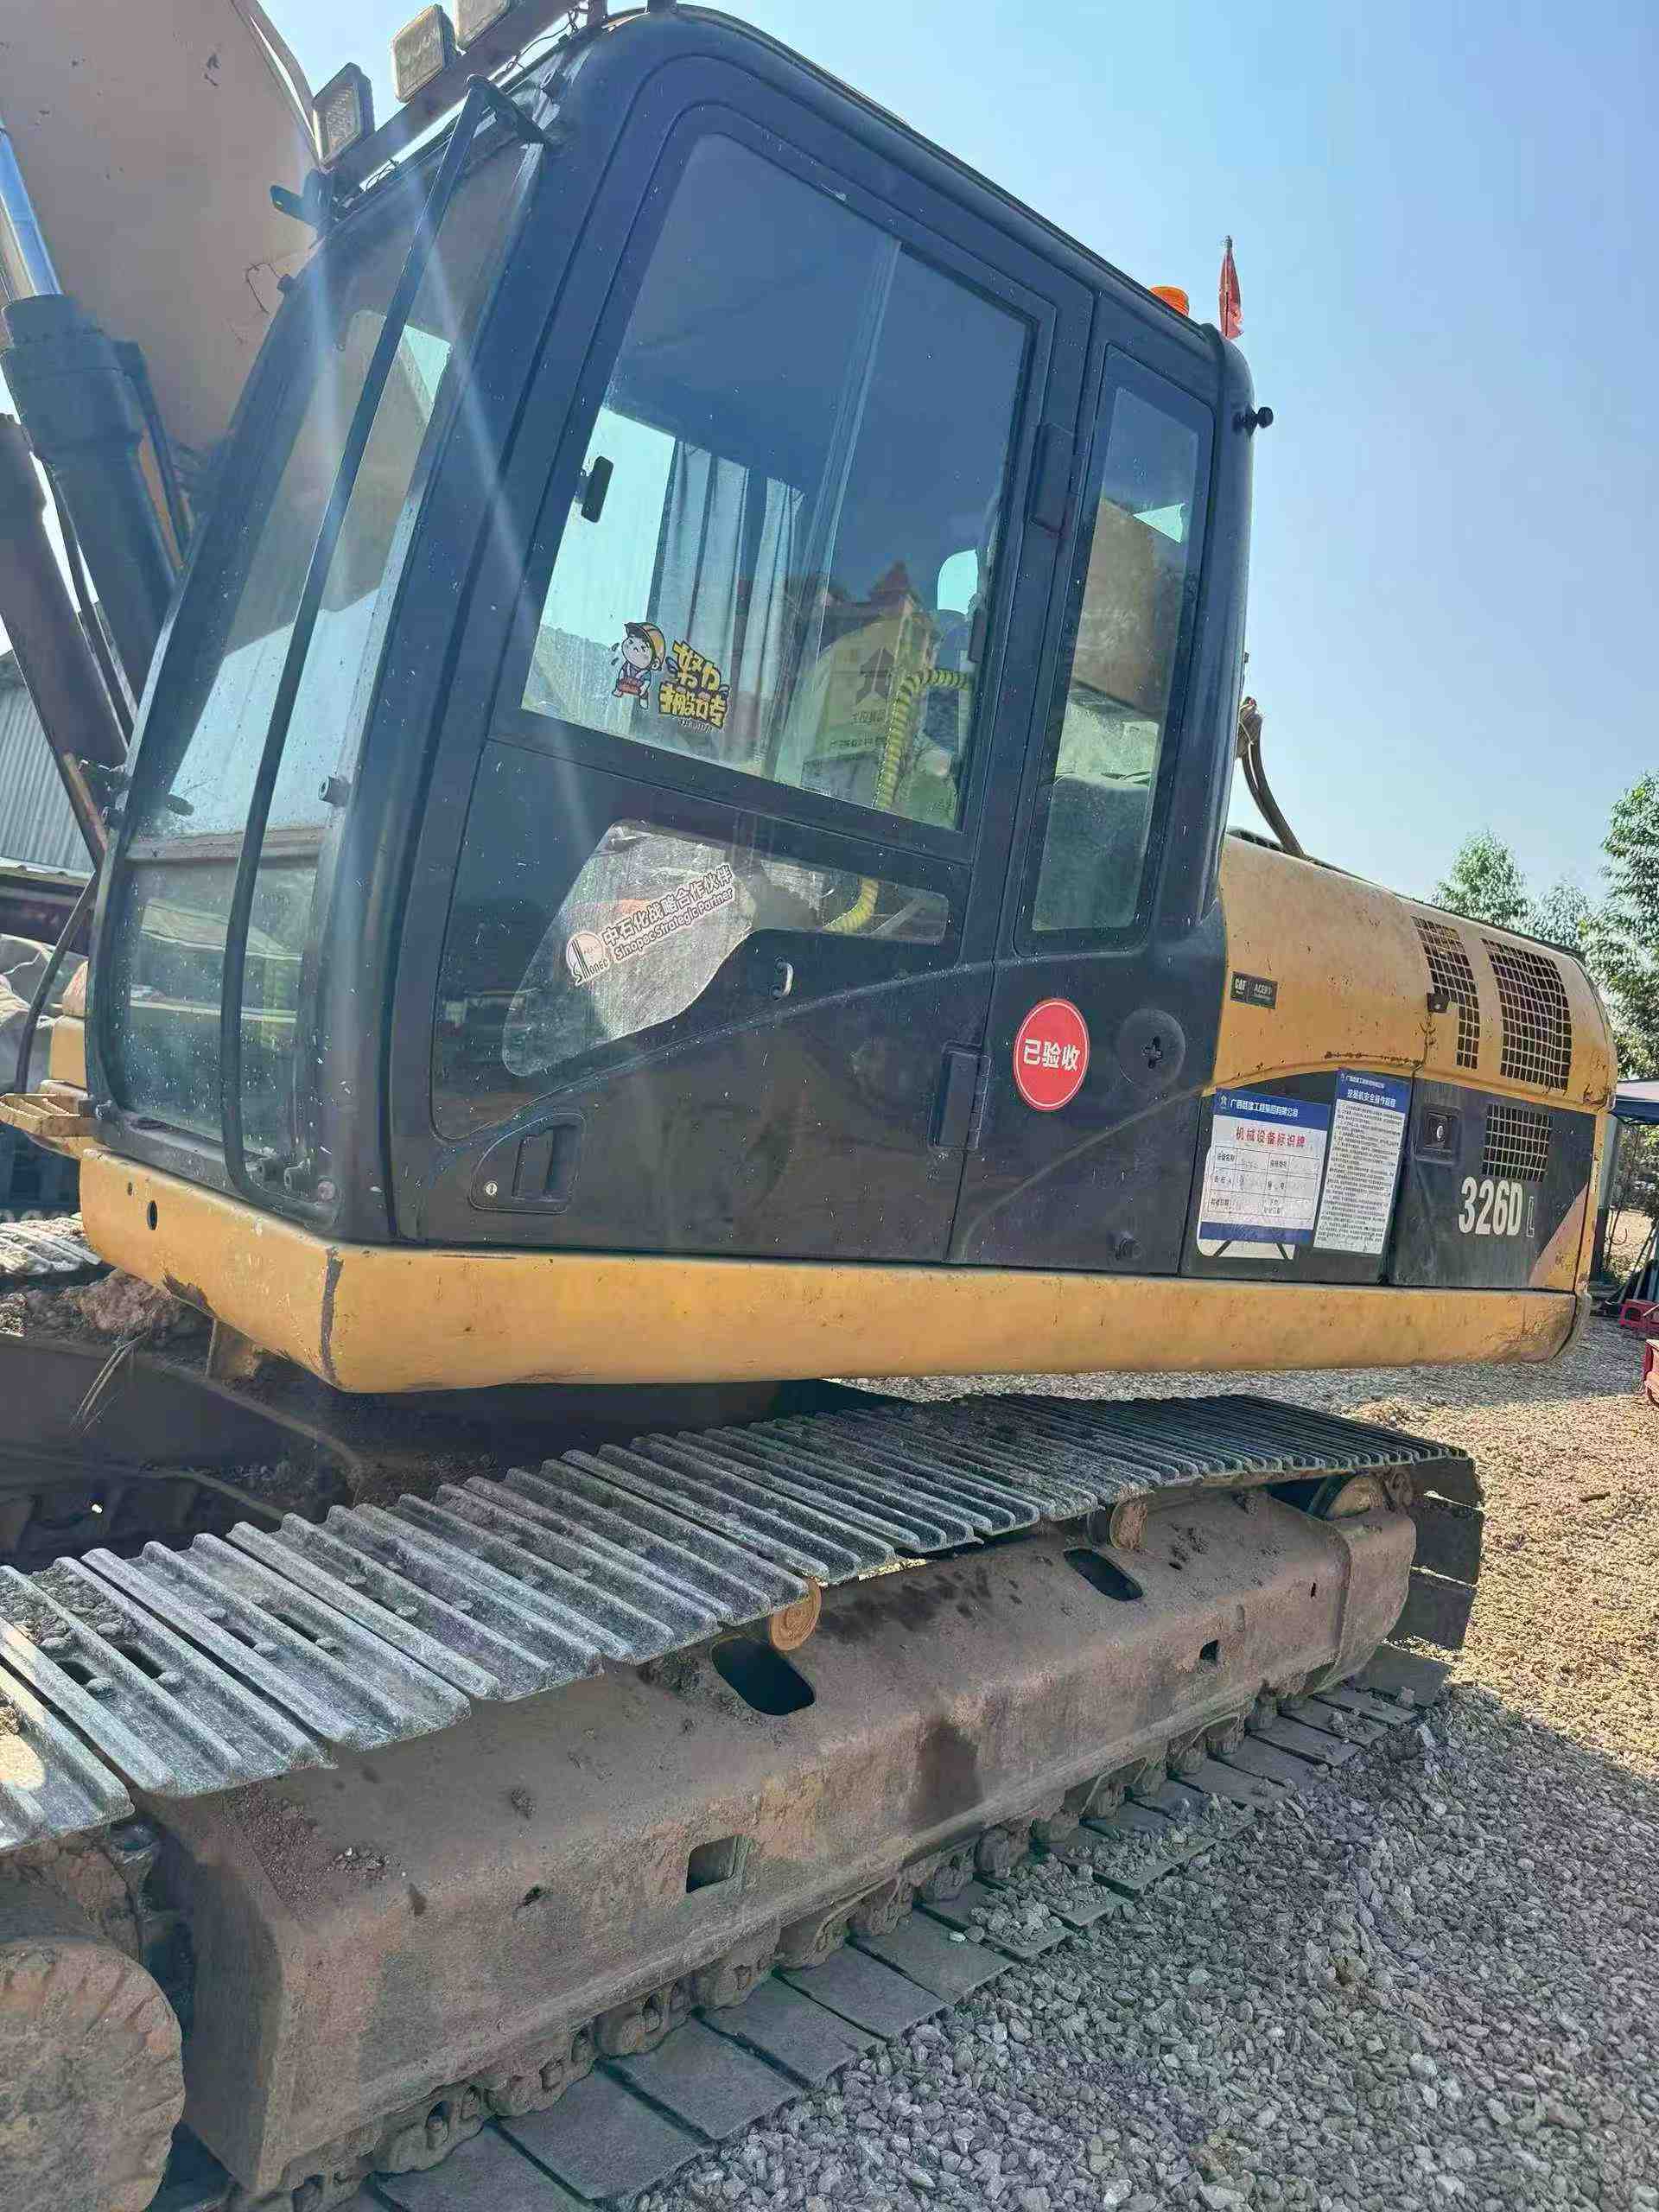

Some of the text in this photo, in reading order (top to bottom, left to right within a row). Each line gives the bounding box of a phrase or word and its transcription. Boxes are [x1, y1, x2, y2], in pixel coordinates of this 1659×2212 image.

[602, 863, 733, 947] 中石化战略合作伙伴
[613, 887, 734, 961] Sinopec Strategic Partner
[1024, 1038, 1081, 1071] 已验收
[1236, 1126, 1306, 1147] 机械设备标识牌
[1458, 1176, 1523, 1236] 326D
